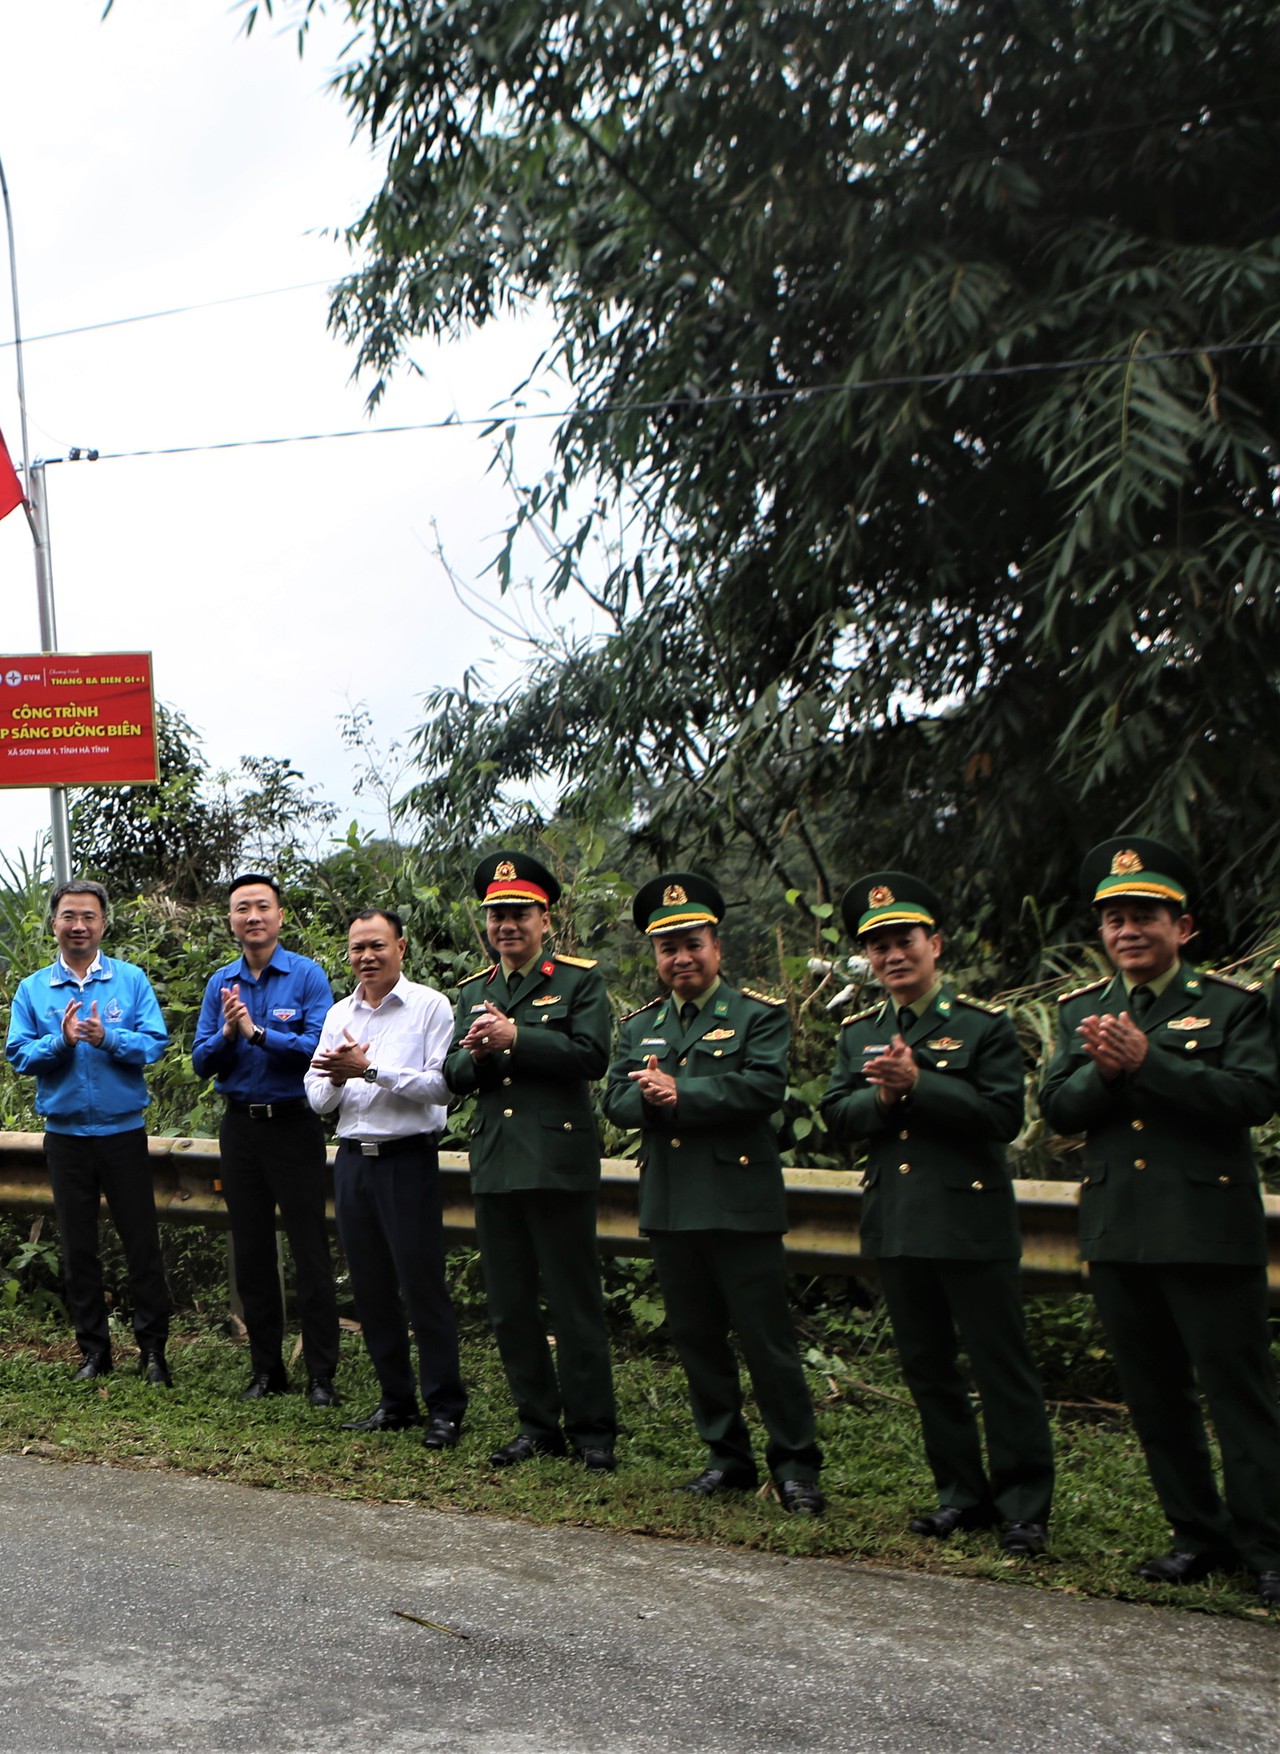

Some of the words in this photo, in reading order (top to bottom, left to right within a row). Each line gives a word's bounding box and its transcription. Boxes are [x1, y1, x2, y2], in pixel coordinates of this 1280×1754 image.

[12, 703, 52, 719] CÔNG
[54, 702, 99, 718] TRÌNH
[11, 723, 49, 739] SÁNG
[51, 721, 104, 738] ĐƯỜNG
[107, 720, 141, 736] BIÊN
[79, 745, 90, 754] HÀ
